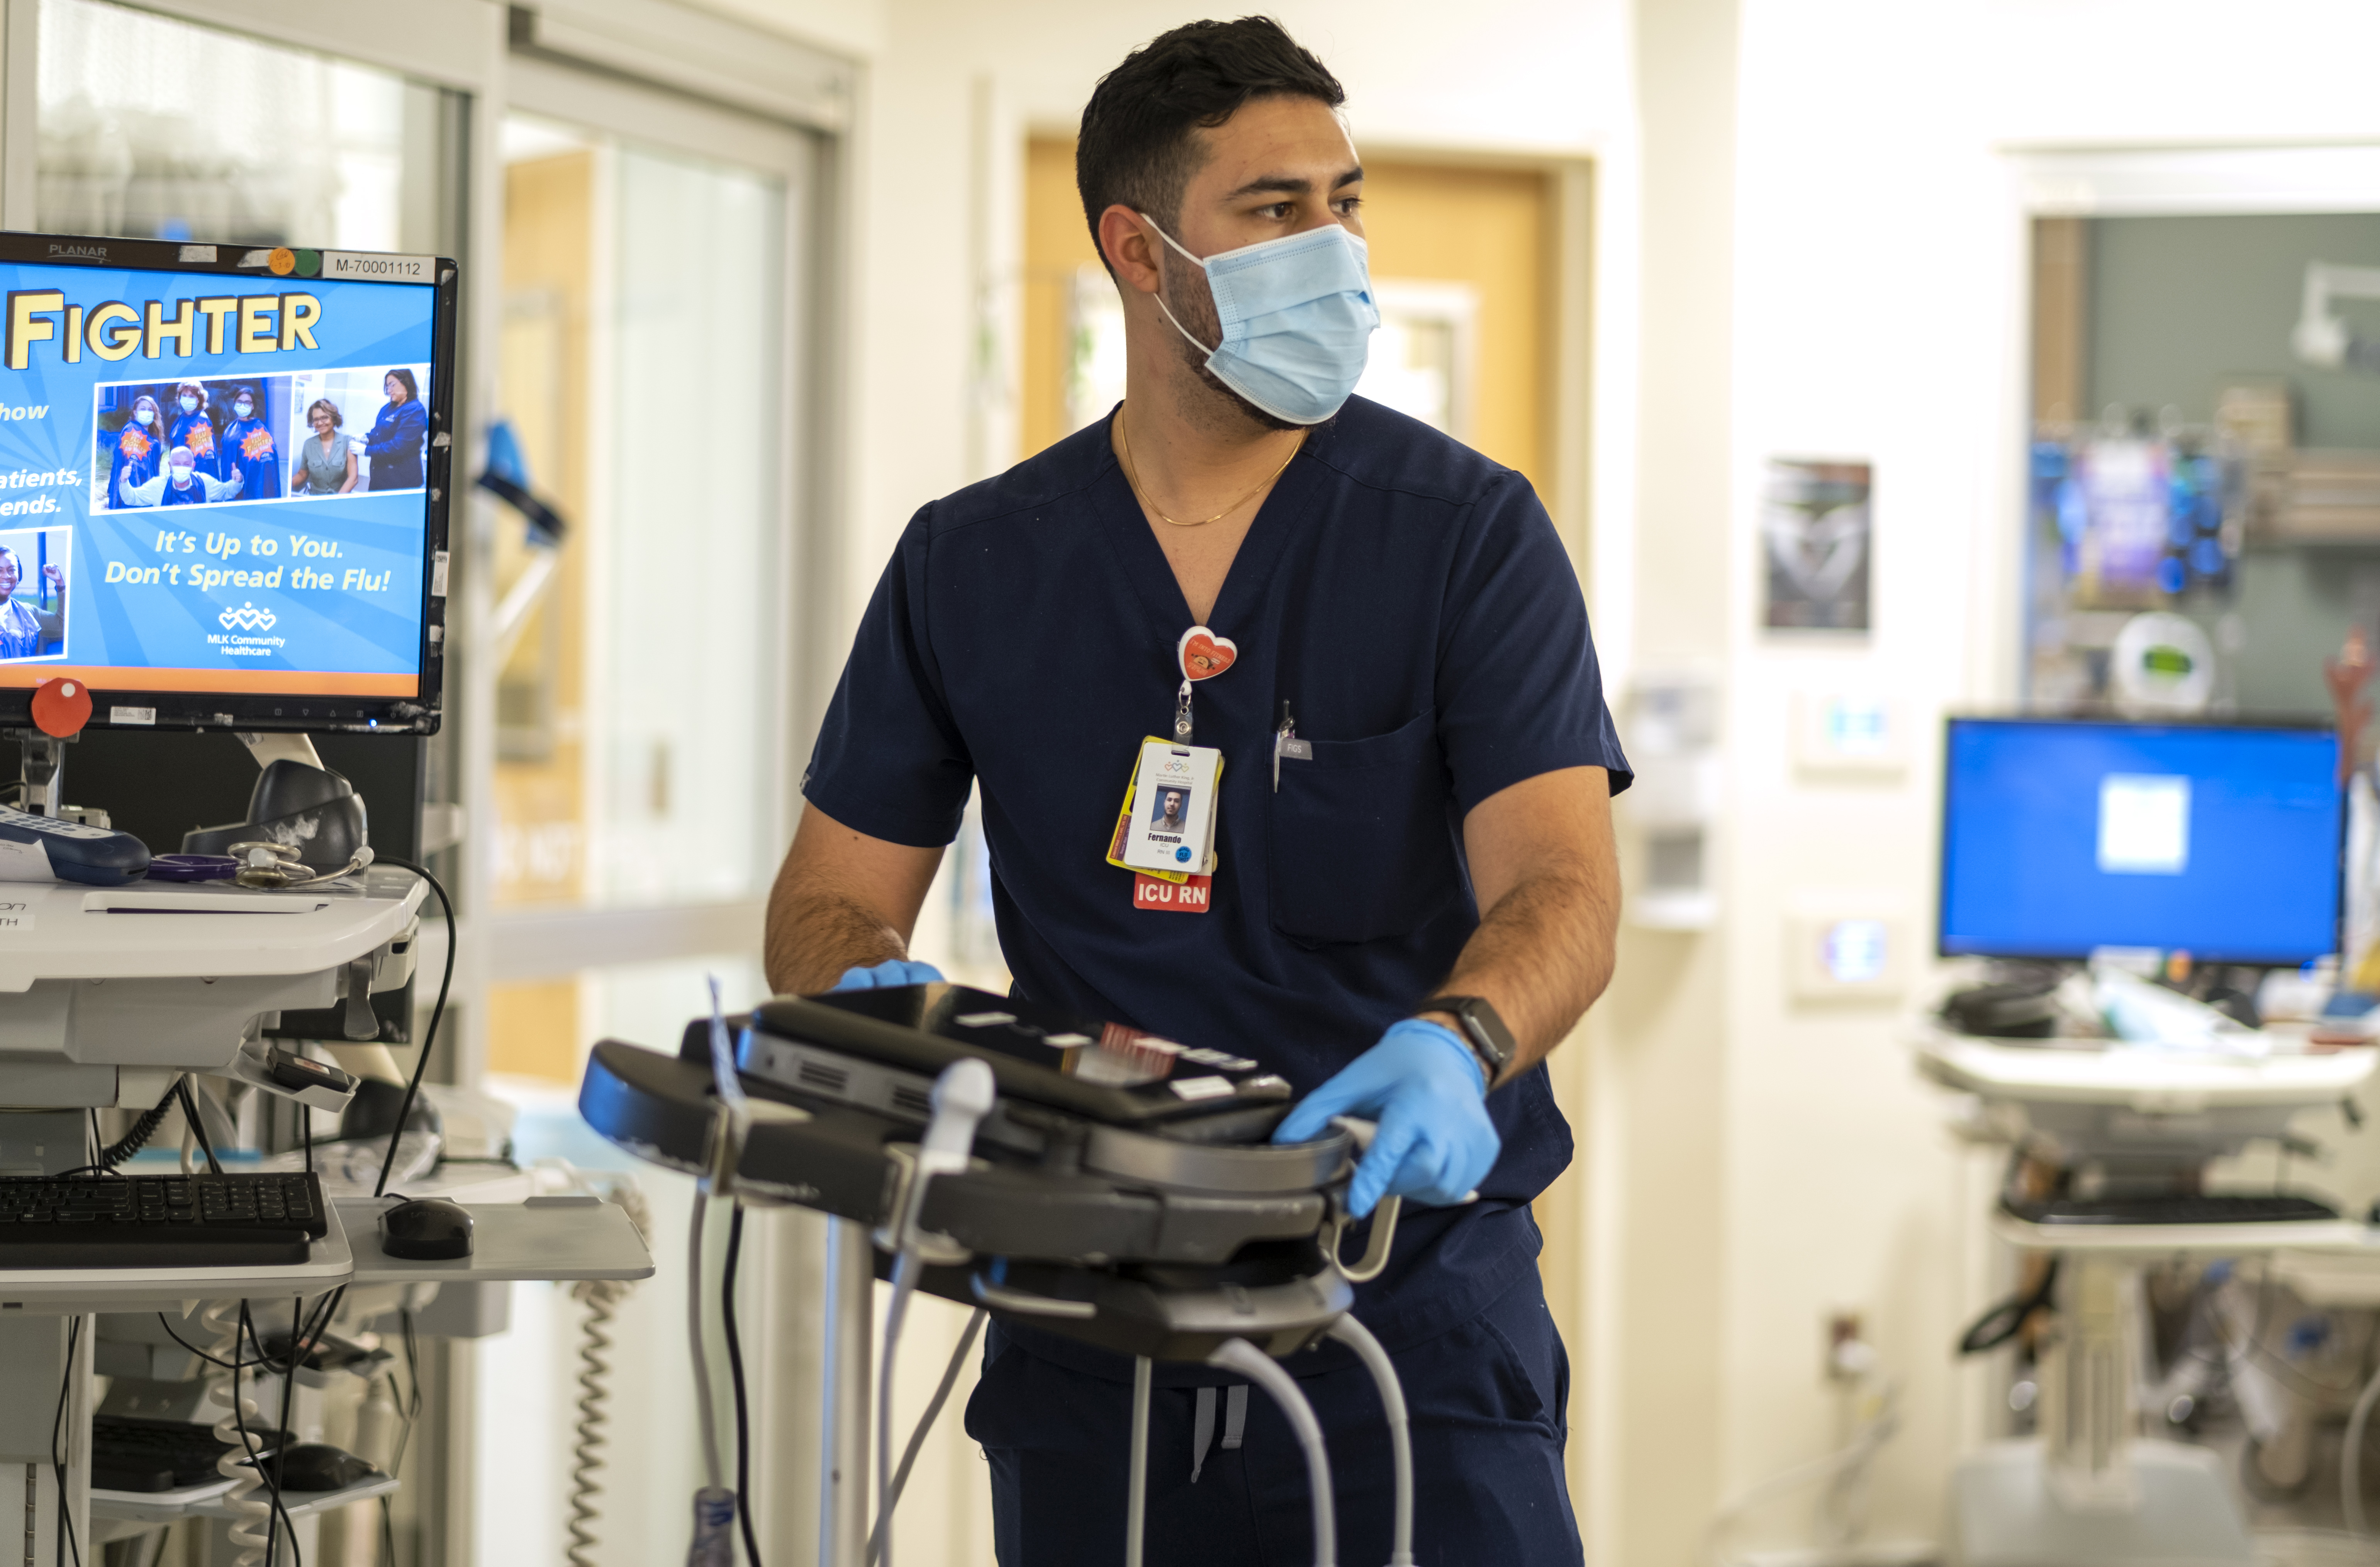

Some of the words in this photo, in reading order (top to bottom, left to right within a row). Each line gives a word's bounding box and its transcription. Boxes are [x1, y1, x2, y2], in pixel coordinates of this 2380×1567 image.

[49, 244, 107, 256] PLANAR
[336, 259, 420, 275] M-70001112
[4, 289, 322, 370] FIGHTER
[155, 530, 196, 553] It's
[205, 532, 241, 560] Up
[251, 535, 278, 556] to
[290, 535, 343, 558] You.
[105, 561, 181, 585] Don't
[188, 564, 284, 592] Spread
[291, 567, 334, 590] the
[342, 568, 391, 592] Flu!
[207, 634, 229, 644] MLK
[231, 635, 285, 648] Community
[221, 645, 271, 656] Healthcare
[1198, 644, 1211, 653] INTO
[1211, 650, 1231, 663] FITNESS
[1287, 744, 1302, 753] FIGS
[1148, 833, 1182, 844] Fernando
[1139, 884, 1172, 902] ICU
[1179, 886, 1206, 904] RN
